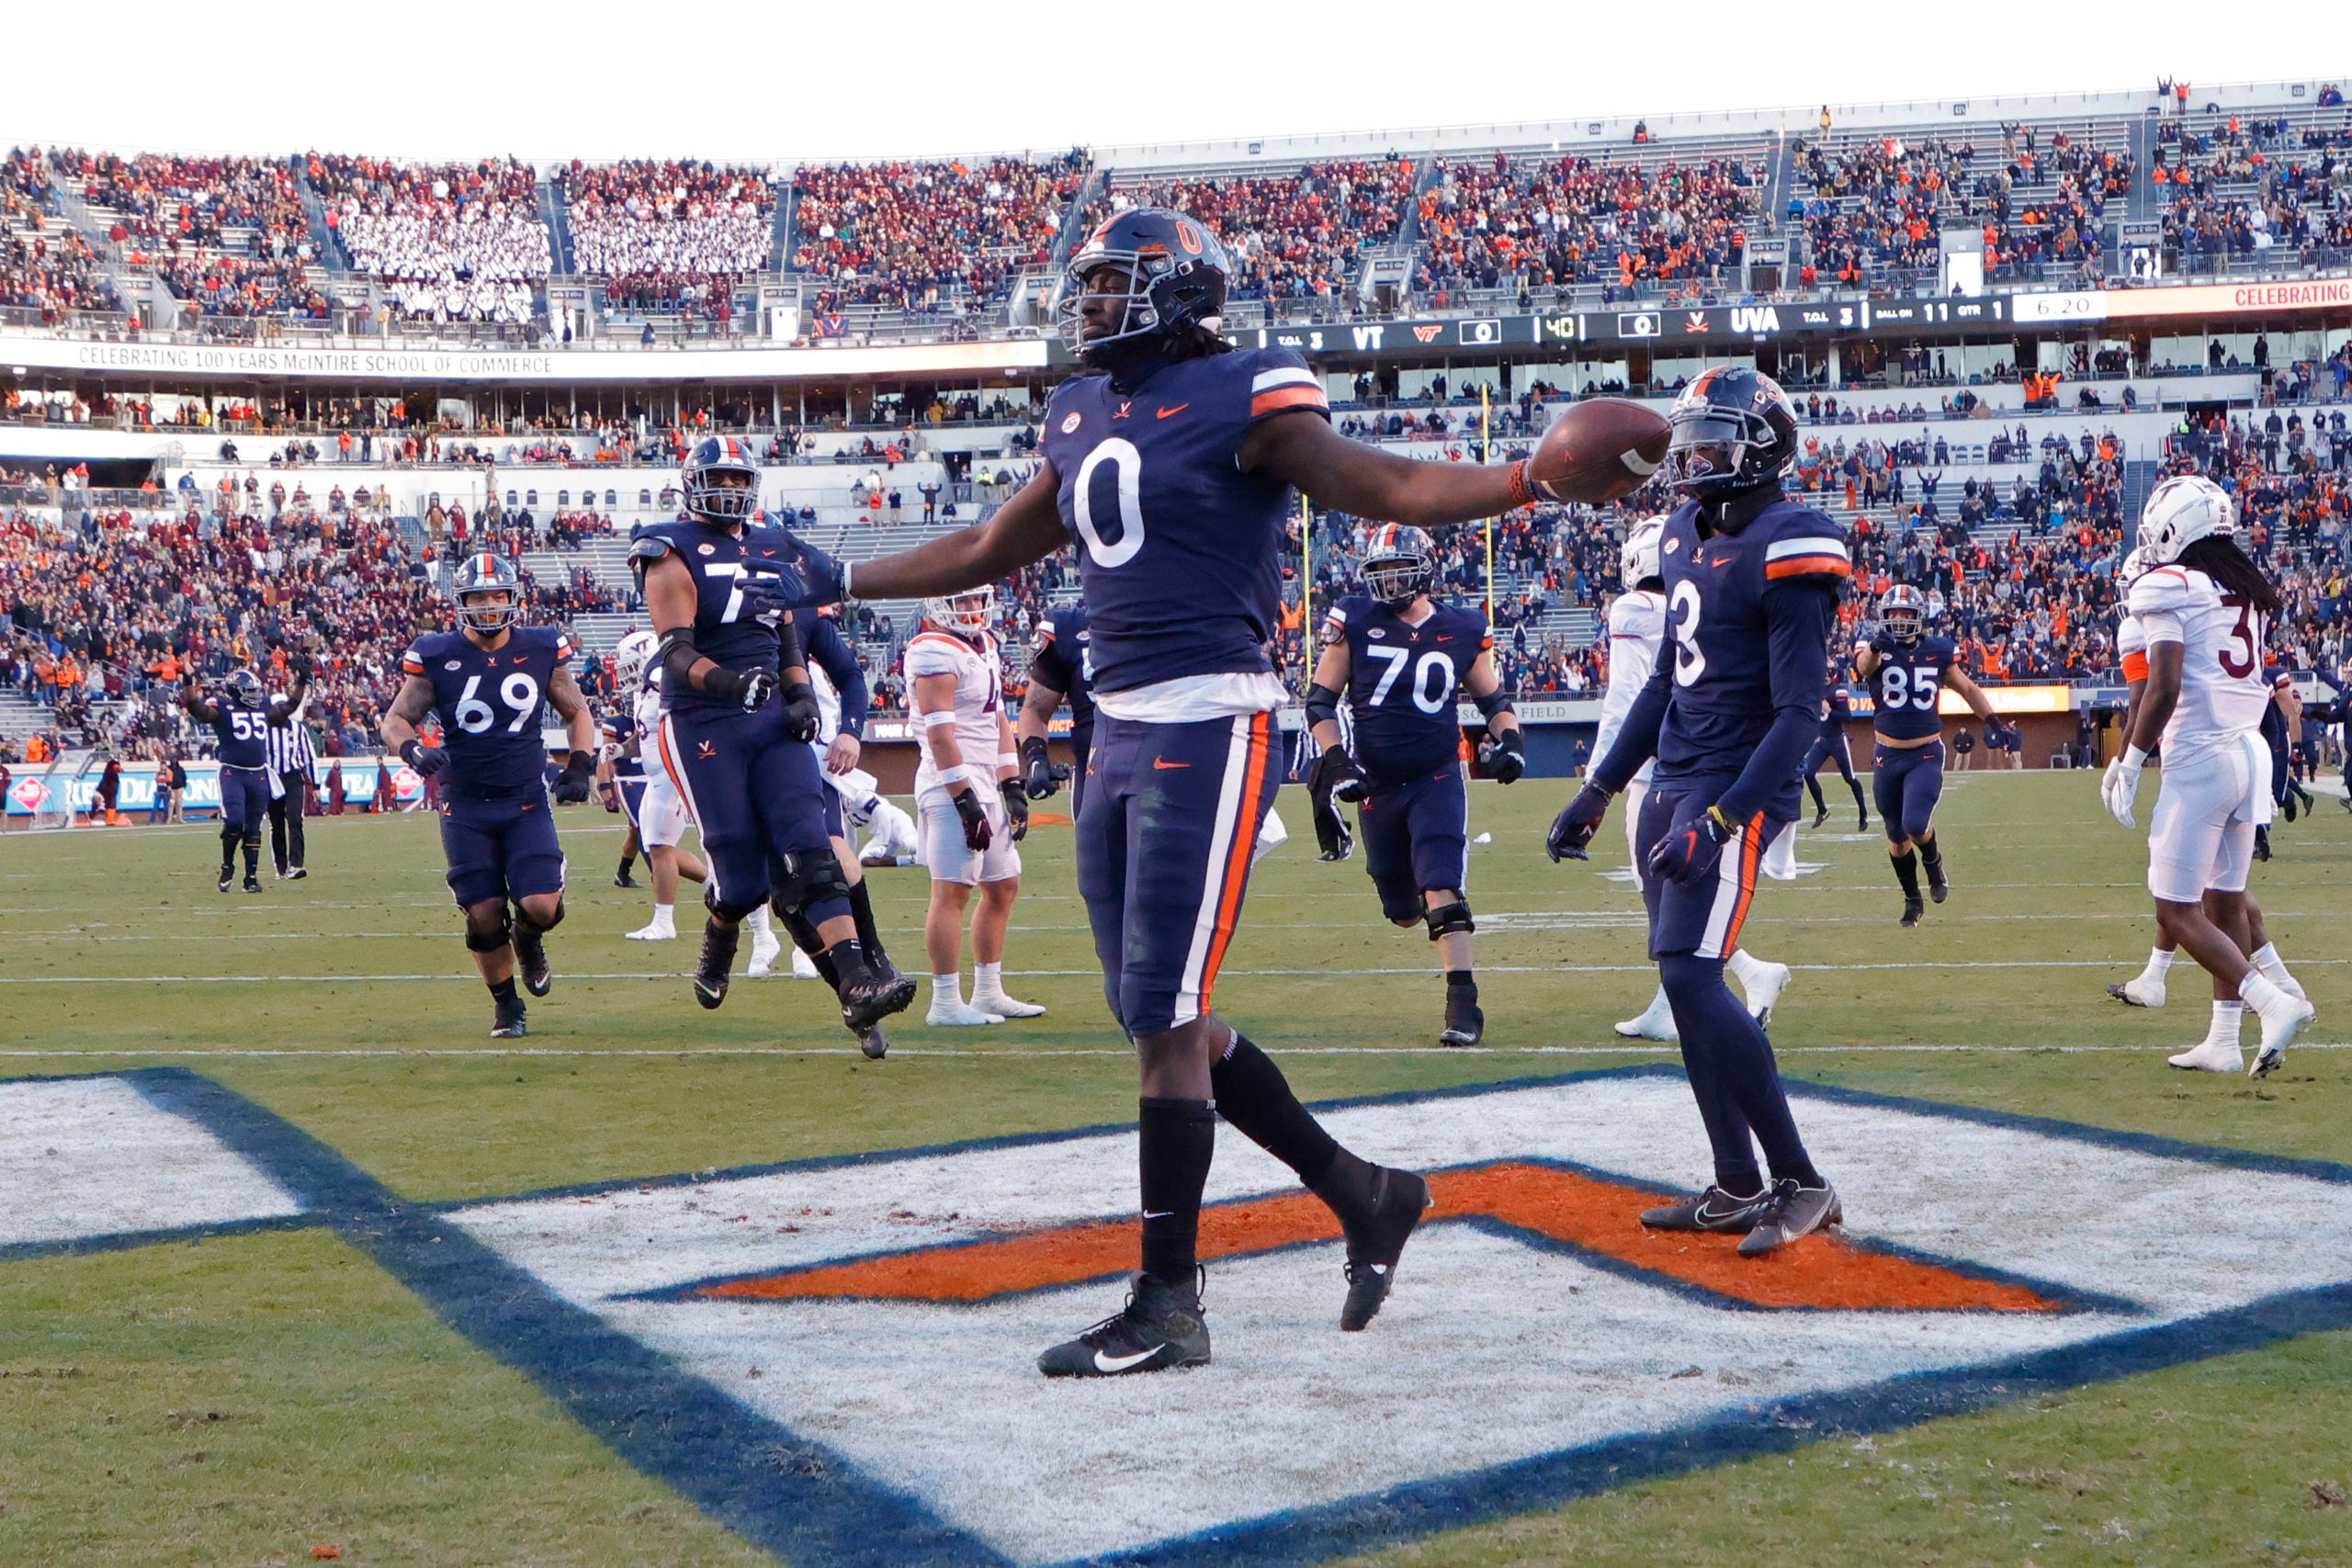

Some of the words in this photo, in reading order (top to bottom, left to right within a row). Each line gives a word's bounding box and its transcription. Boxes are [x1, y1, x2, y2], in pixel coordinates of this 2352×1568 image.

[1176, 220, 1203, 254] 0
[2038, 297, 2090, 315] 6:20
[2235, 283, 2350, 306] CELEBRATING
[1731, 307, 1781, 332] UVA
[1840, 308, 1853, 325] 3
[1876, 310, 1897, 319] BALL
[1899, 309, 1913, 318] ON
[1925, 303, 1949, 321] 11
[1958, 304, 1981, 316] QTR
[1993, 300, 2002, 320] 1
[1476, 322, 1492, 342] 0
[1546, 317, 1574, 337] 40
[1634, 315, 1651, 334] 0
[1310, 332, 1323, 349] 3
[1352, 326, 1385, 350] VT
[80, 346, 188, 367] CELEBRATING
[197, 351, 224, 367] 100
[229, 353, 277, 369] YEARS
[284, 354, 359, 370] McINTIRE
[366, 355, 427, 372] SCHOOL
[435, 356, 452, 372] OF
[459, 356, 551, 373] COMMERCE
[1757, 375, 1782, 401] 3
[1074, 437, 1145, 568] 0
[1670, 579, 1706, 687] 3
[1367, 644, 1455, 714] 70
[1882, 666, 1939, 711] 85
[455, 672, 538, 733] 69
[1521, 706, 1566, 717] FIELD
[231, 712, 268, 740] 55
[875, 725, 903, 738] YOUR
[1047, 719, 1076, 733] VICT
